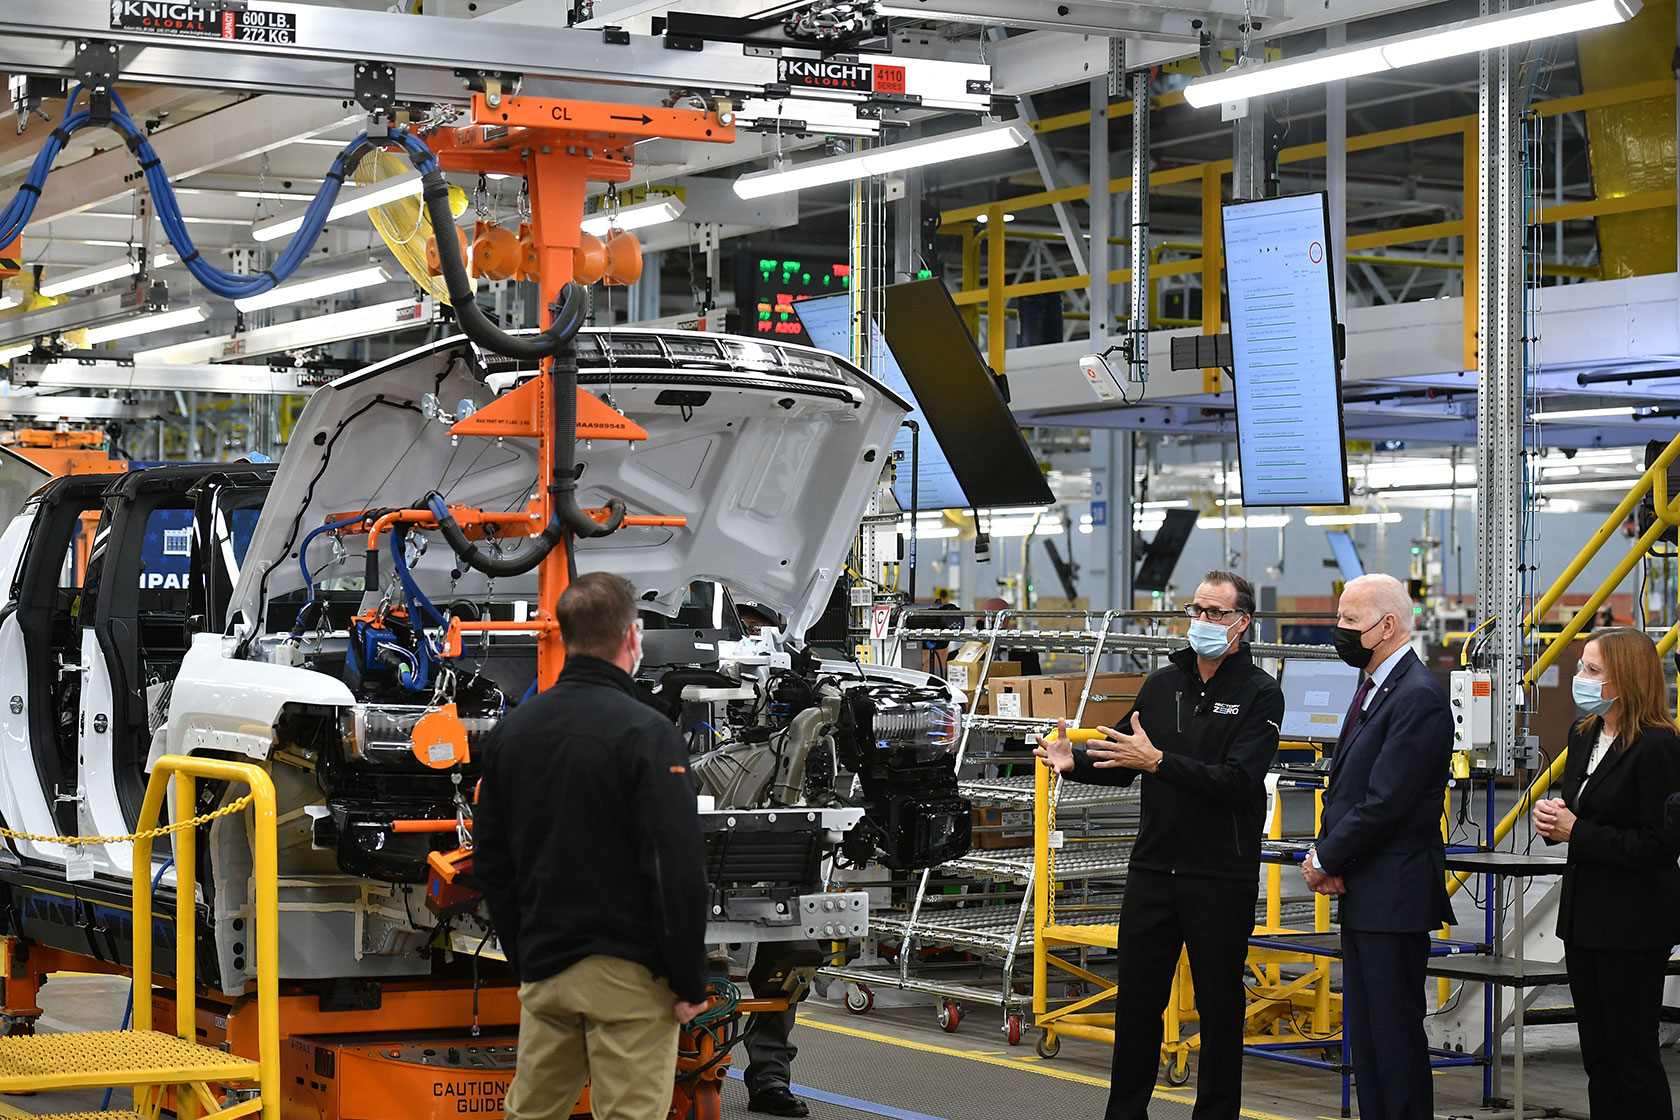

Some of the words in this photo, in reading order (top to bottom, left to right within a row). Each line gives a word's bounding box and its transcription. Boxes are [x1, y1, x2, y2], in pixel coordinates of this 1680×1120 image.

[124, 1, 221, 22] KNIGHT
[142, 17, 204, 30] GLOBAL
[224, 11, 233, 39] CAPACIT
[242, 13, 265, 27] 600
[268, 14, 290, 28] LB.
[242, 28, 265, 42] 272
[268, 29, 292, 44] KG.
[789, 61, 871, 80] KNIGHT
[877, 69, 903, 82] 4110
[804, 76, 856, 88] GLOBAL
[877, 81, 902, 91] SERIES
[551, 106, 572, 121] CL
[877, 611, 884, 624] C
[1212, 706, 1239, 715] ZERO
